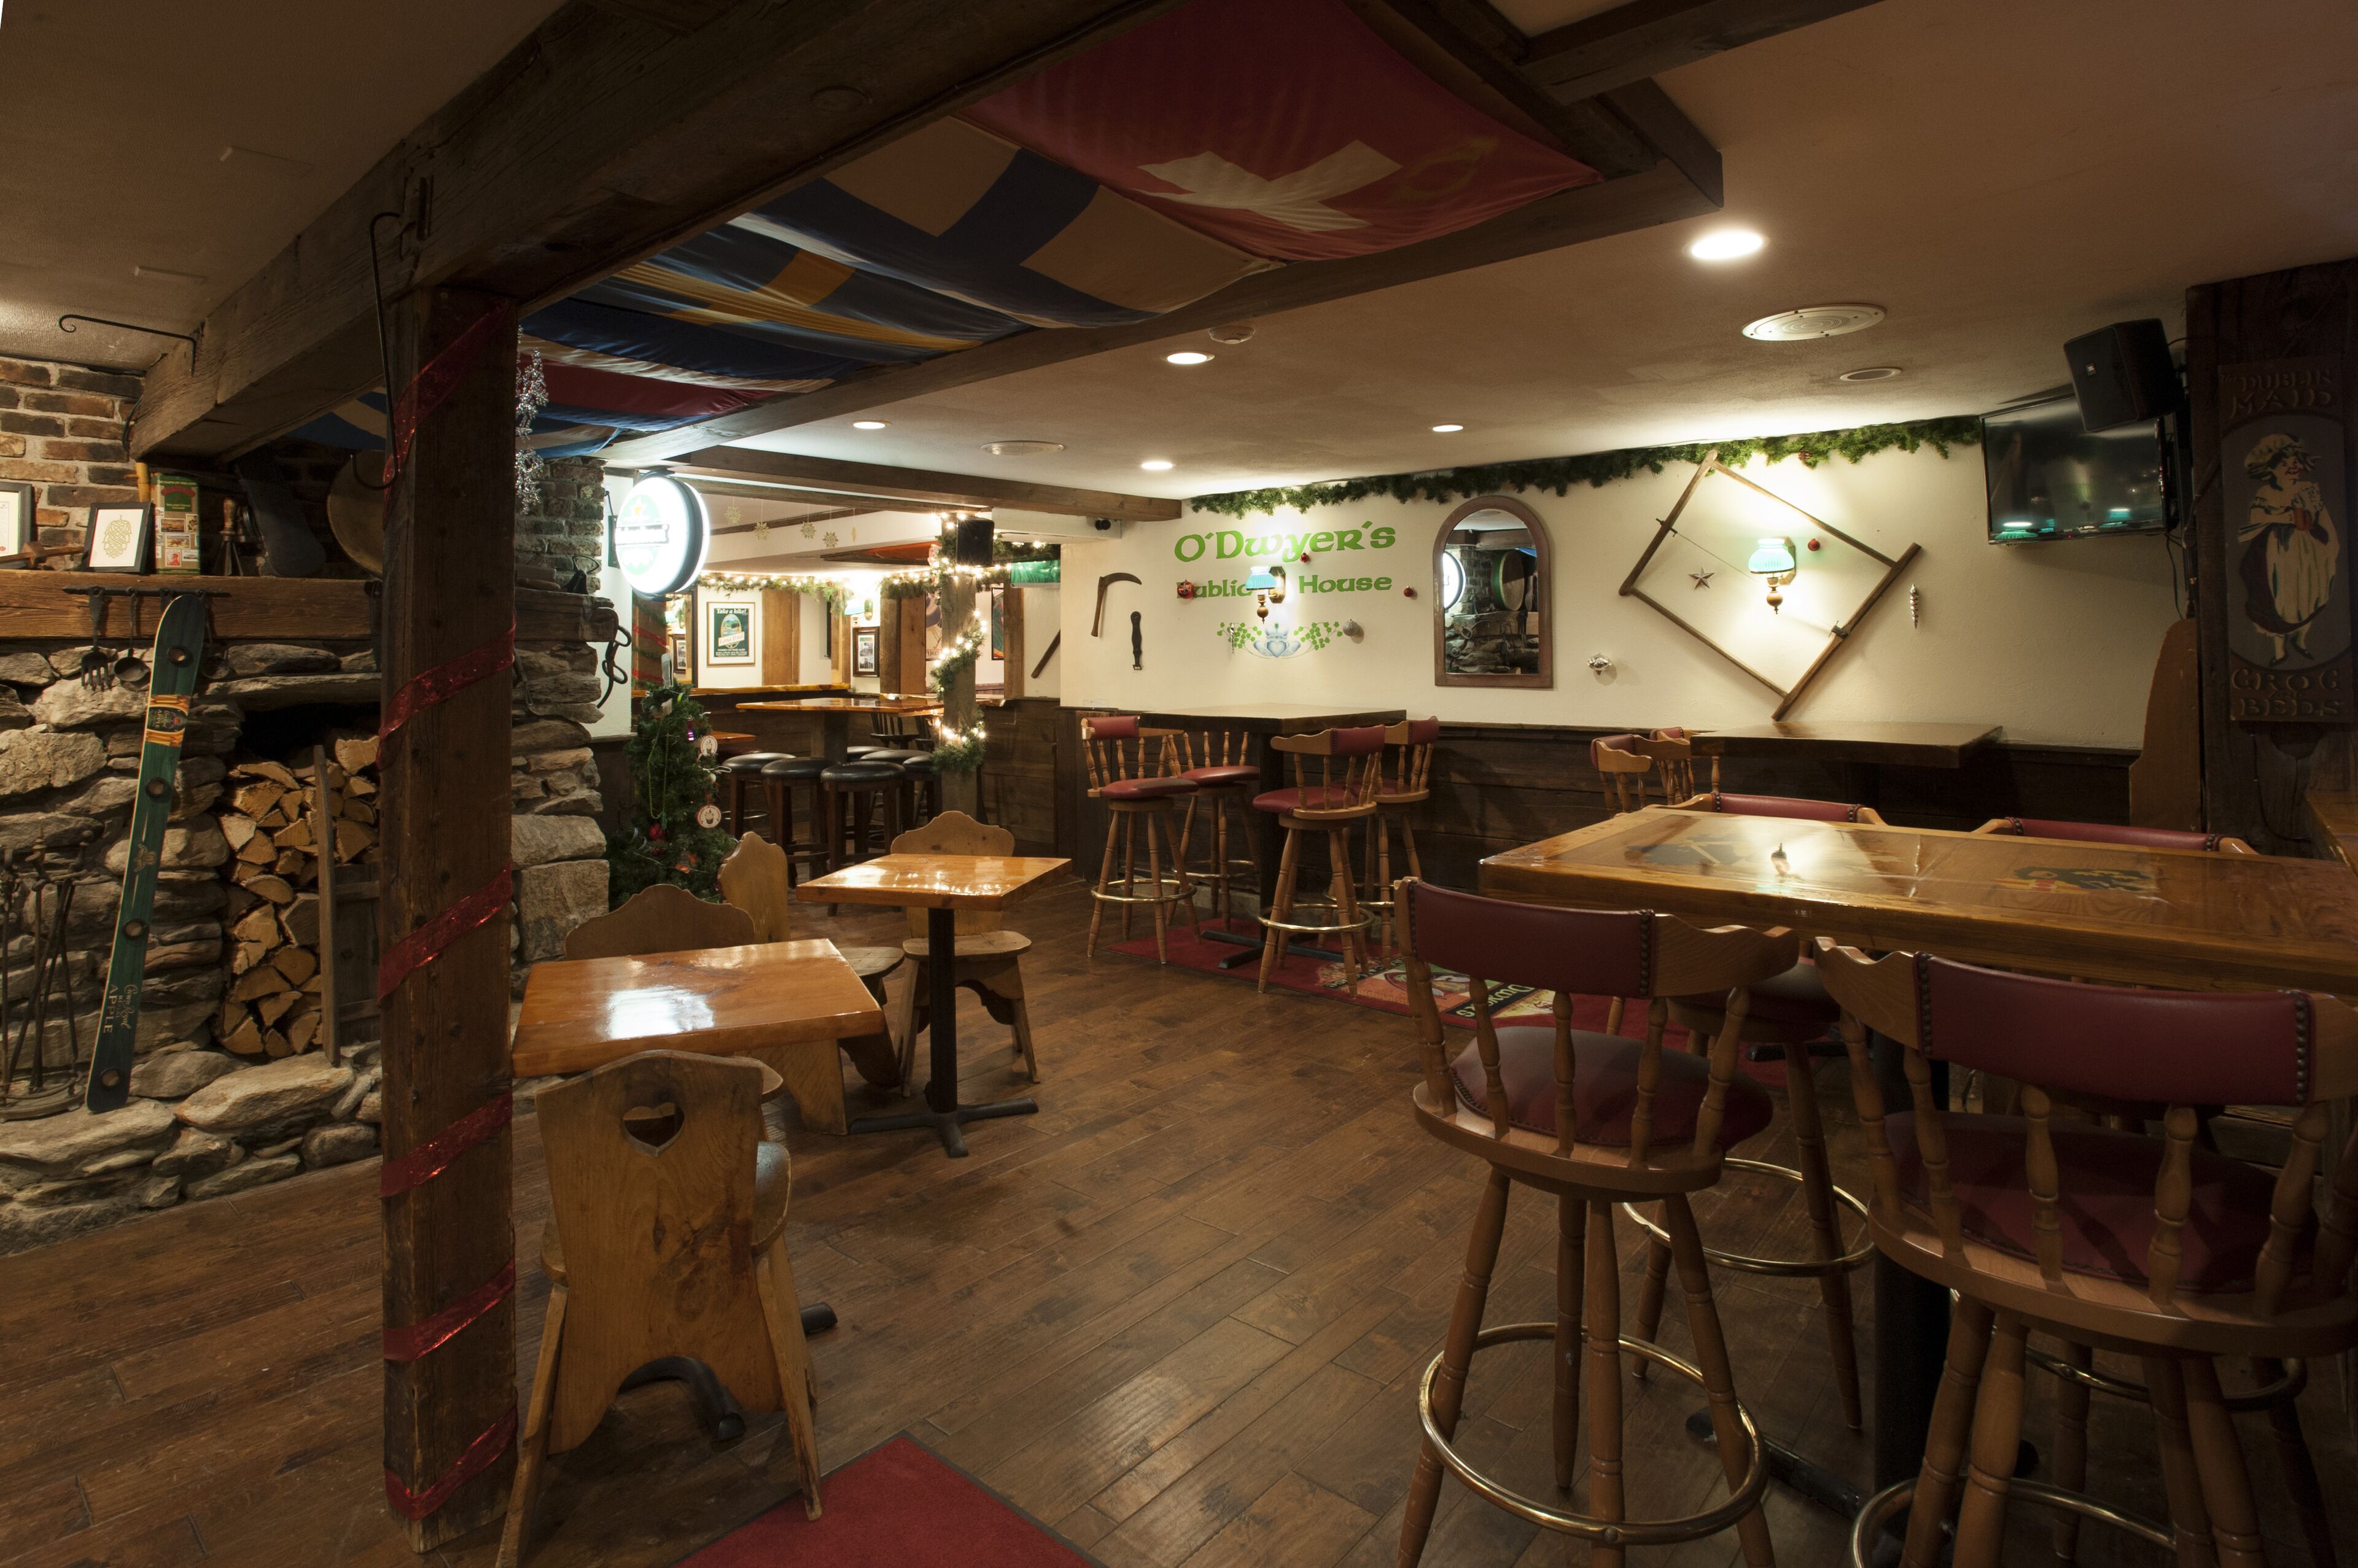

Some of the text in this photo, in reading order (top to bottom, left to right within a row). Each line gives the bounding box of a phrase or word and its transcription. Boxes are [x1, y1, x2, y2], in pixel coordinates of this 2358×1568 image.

[2230, 388, 2332, 419] MAID
[1174, 521, 1396, 563] O'Dwyer's
[1299, 575, 1392, 594] House
[2232, 668, 2339, 691] GROG
[2239, 698, 2340, 717] BEDS
[103, 984, 119, 1034] APPLE
[120, 1004, 135, 1030] Royal
